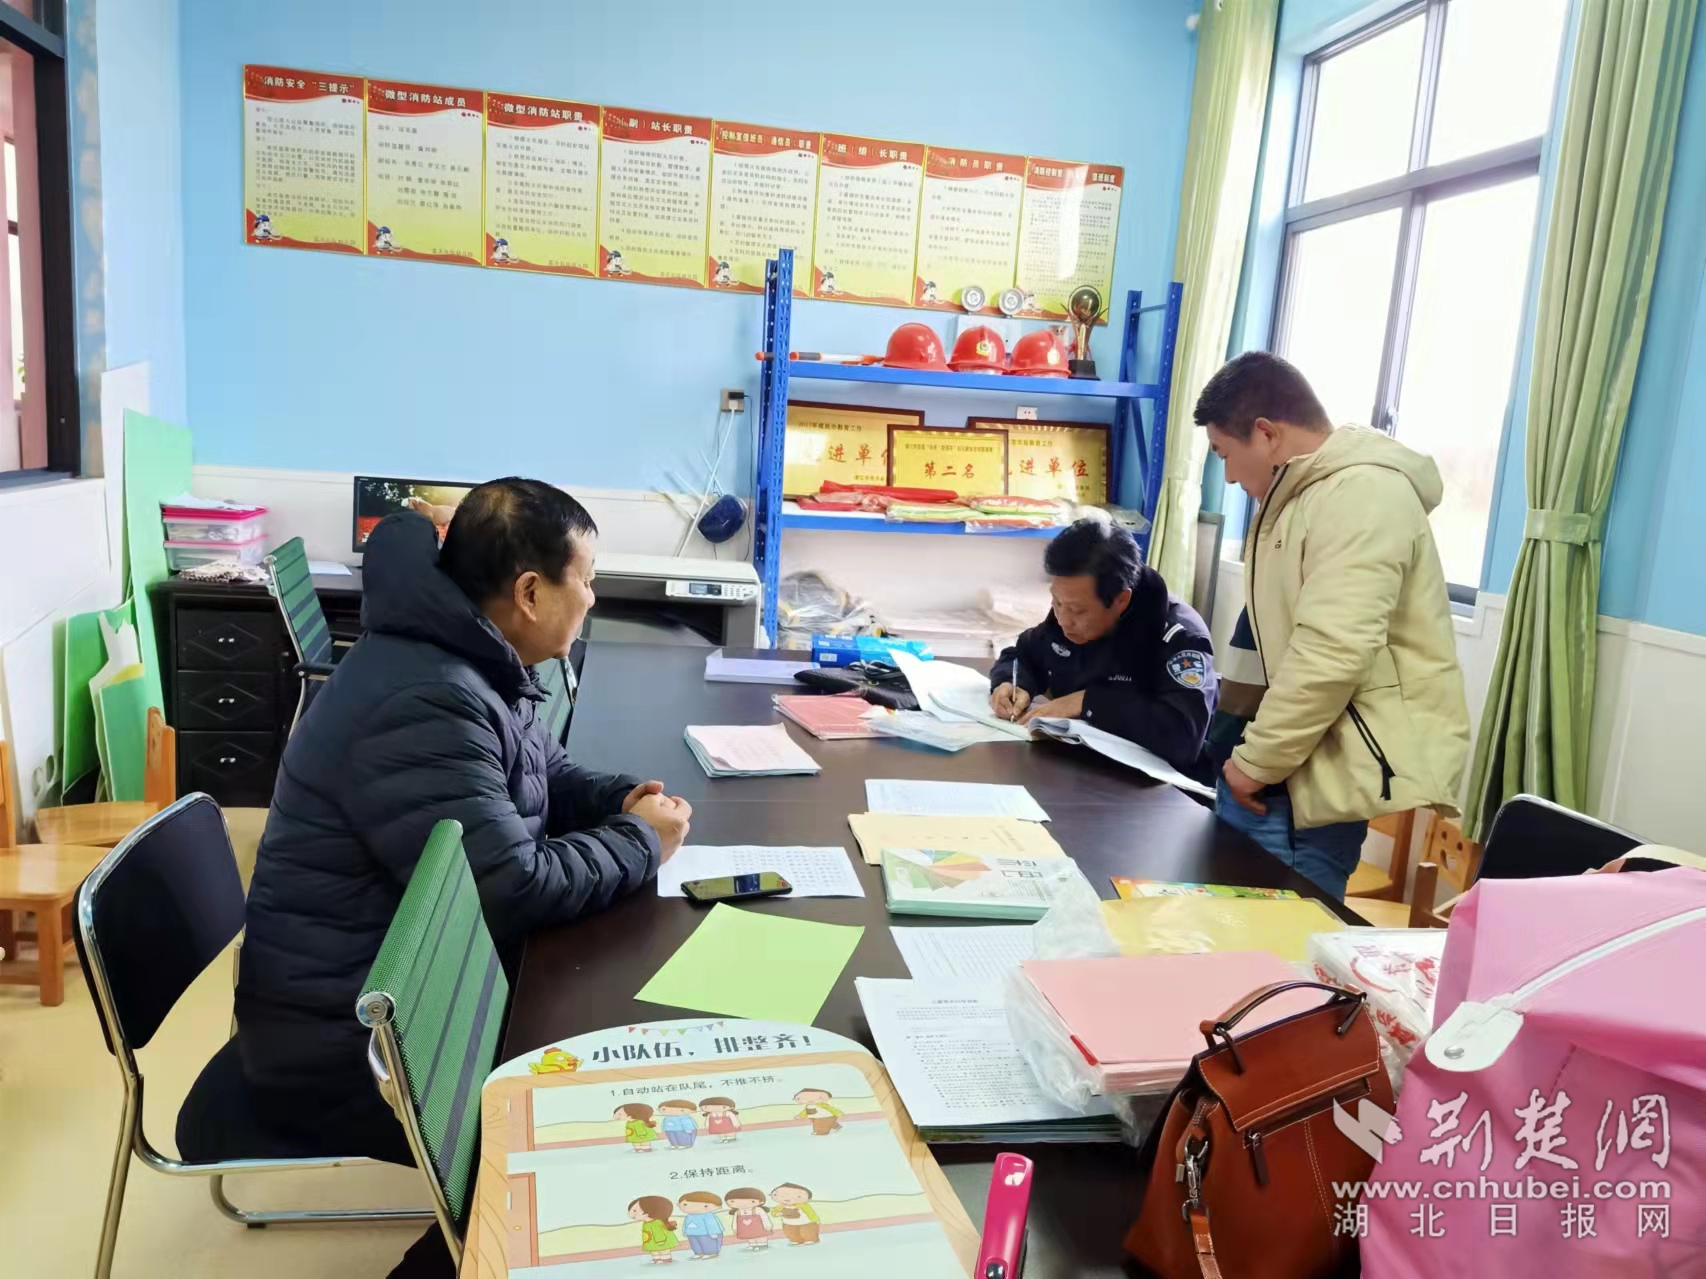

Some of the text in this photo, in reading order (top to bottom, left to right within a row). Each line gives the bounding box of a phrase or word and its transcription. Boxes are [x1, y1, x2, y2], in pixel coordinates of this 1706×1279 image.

[384, 90, 467, 108] 微型消防站成员
[503, 102, 584, 122] 微型消防站职责
[924, 460, 975, 479] 第二名
[1018, 456, 1089, 479] 进单位
